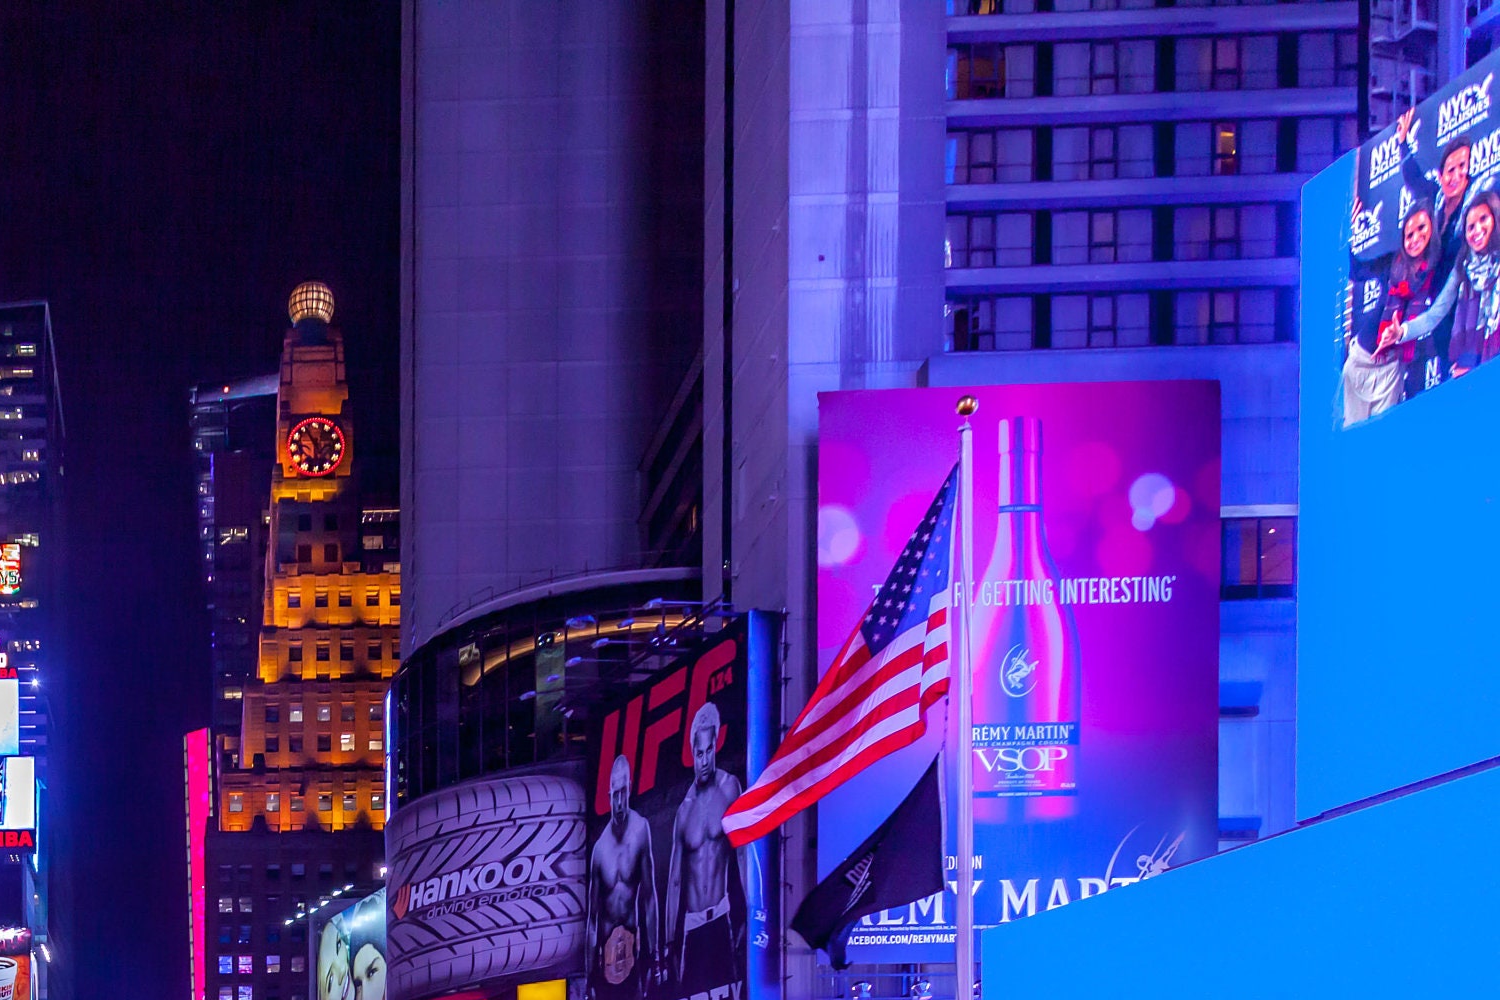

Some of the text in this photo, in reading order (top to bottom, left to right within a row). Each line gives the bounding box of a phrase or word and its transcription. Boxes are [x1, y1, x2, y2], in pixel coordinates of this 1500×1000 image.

[982, 578, 1055, 606] GETTING
[595, 638, 737, 816] UFC
[1014, 725, 1069, 740] MARTIN
[973, 747, 1068, 773] VSOP
[427, 884, 560, 919] driving emotion
